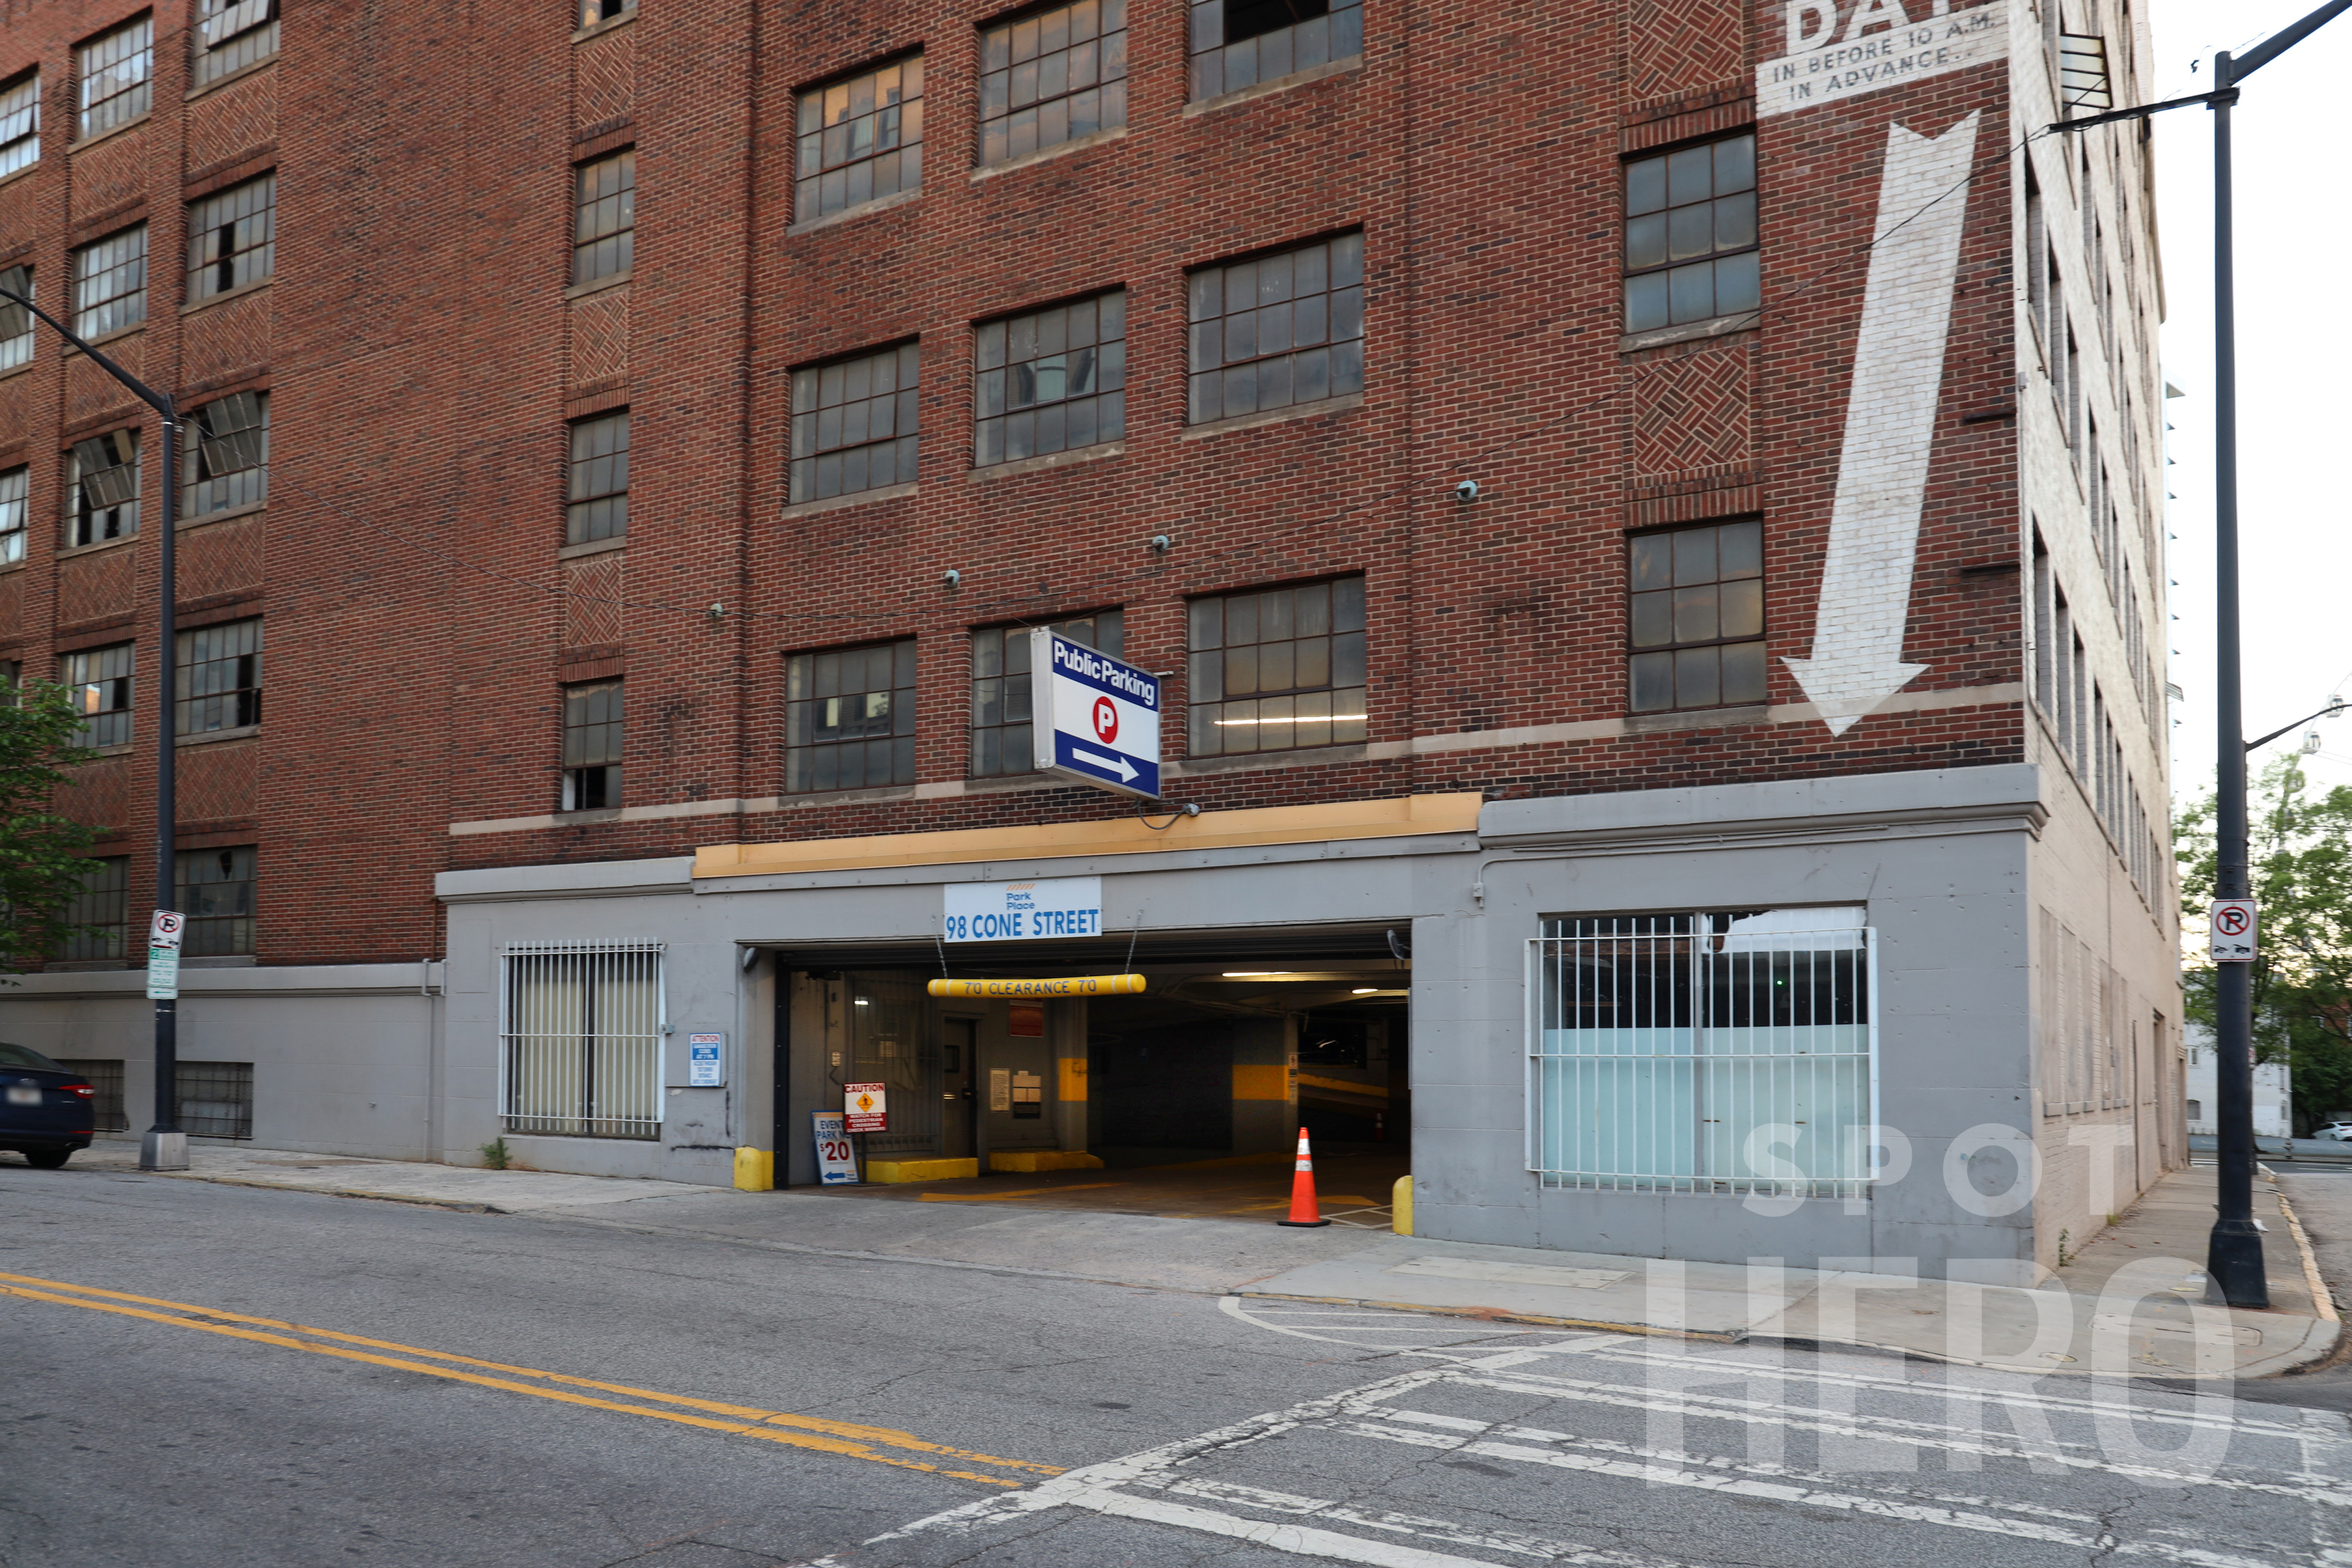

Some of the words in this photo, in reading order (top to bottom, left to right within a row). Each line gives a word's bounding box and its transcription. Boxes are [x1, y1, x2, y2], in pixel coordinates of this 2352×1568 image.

[1774, 67, 1795, 84] IN
[1809, 39, 1892, 74] BEFORE
[1909, 28, 1933, 49] 10
[1946, 13, 1996, 39] A.M.
[1790, 83, 1811, 102] IN
[1054, 641, 1101, 679] Public
[1101, 660, 1155, 706] Parking
[1098, 703, 1115, 734] P
[1006, 892, 1032, 901] Park
[1006, 901, 1035, 910] Place
[947, 916, 967, 939] 98
[973, 913, 1023, 938] CONE
[1033, 909, 1099, 936] STREET
[989, 981, 1070, 995] CLEARANCE
[845, 1084, 885, 1093] CAUTION
[820, 1120, 844, 1129] EVENT
[820, 1141, 850, 1161] $20
